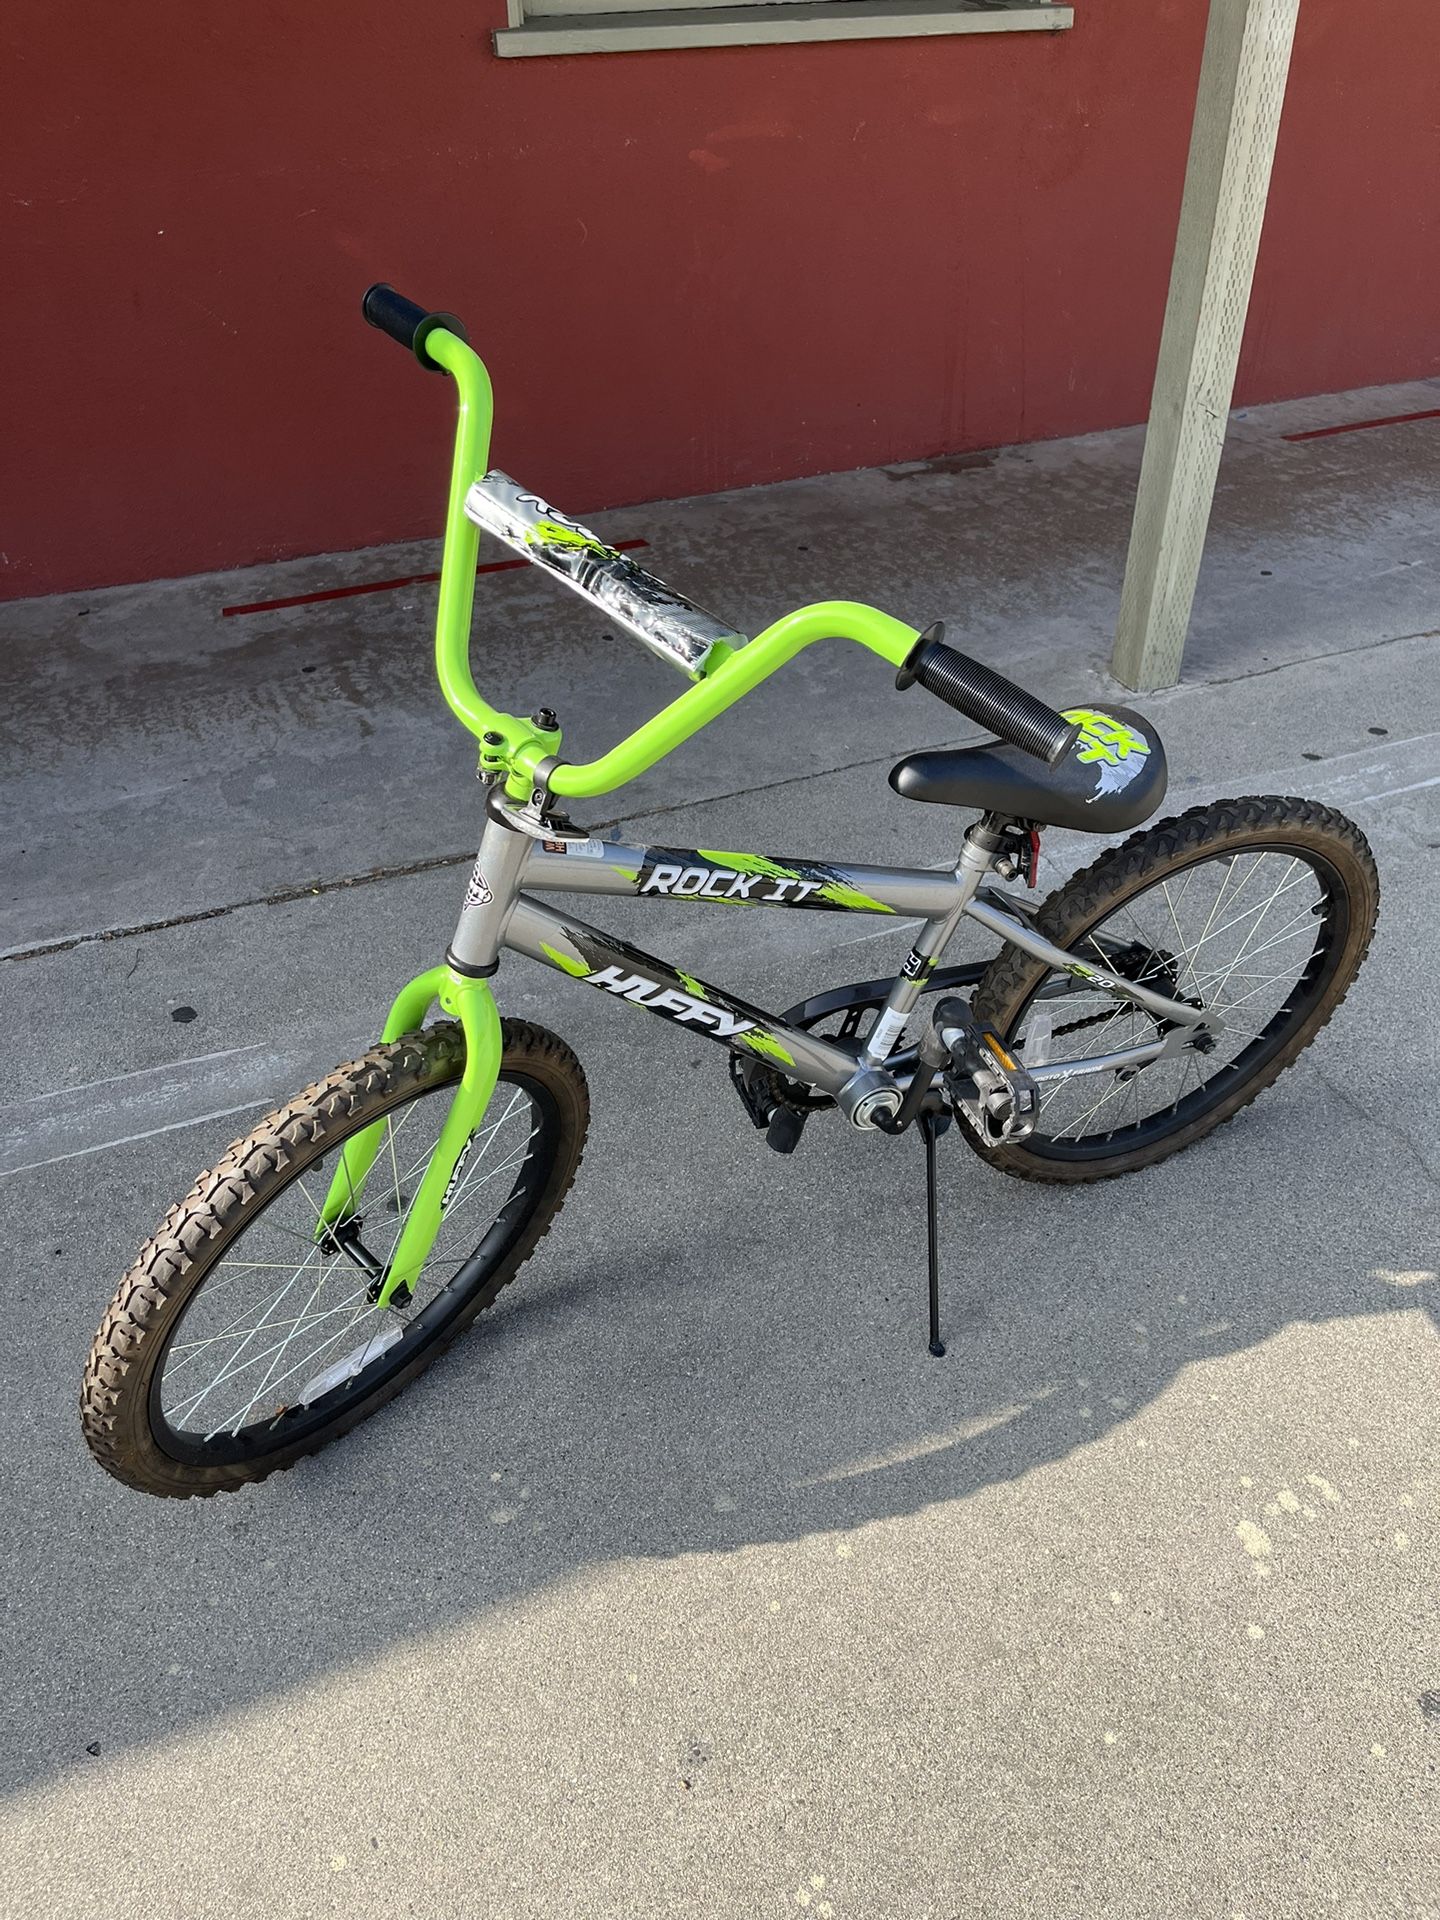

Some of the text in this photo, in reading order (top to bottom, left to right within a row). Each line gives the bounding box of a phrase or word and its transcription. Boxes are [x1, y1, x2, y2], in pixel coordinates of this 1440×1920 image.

[640, 863, 824, 903] ROCK IT
[583, 964, 758, 1036] HUFFY
[1087, 974, 1116, 989] 20
